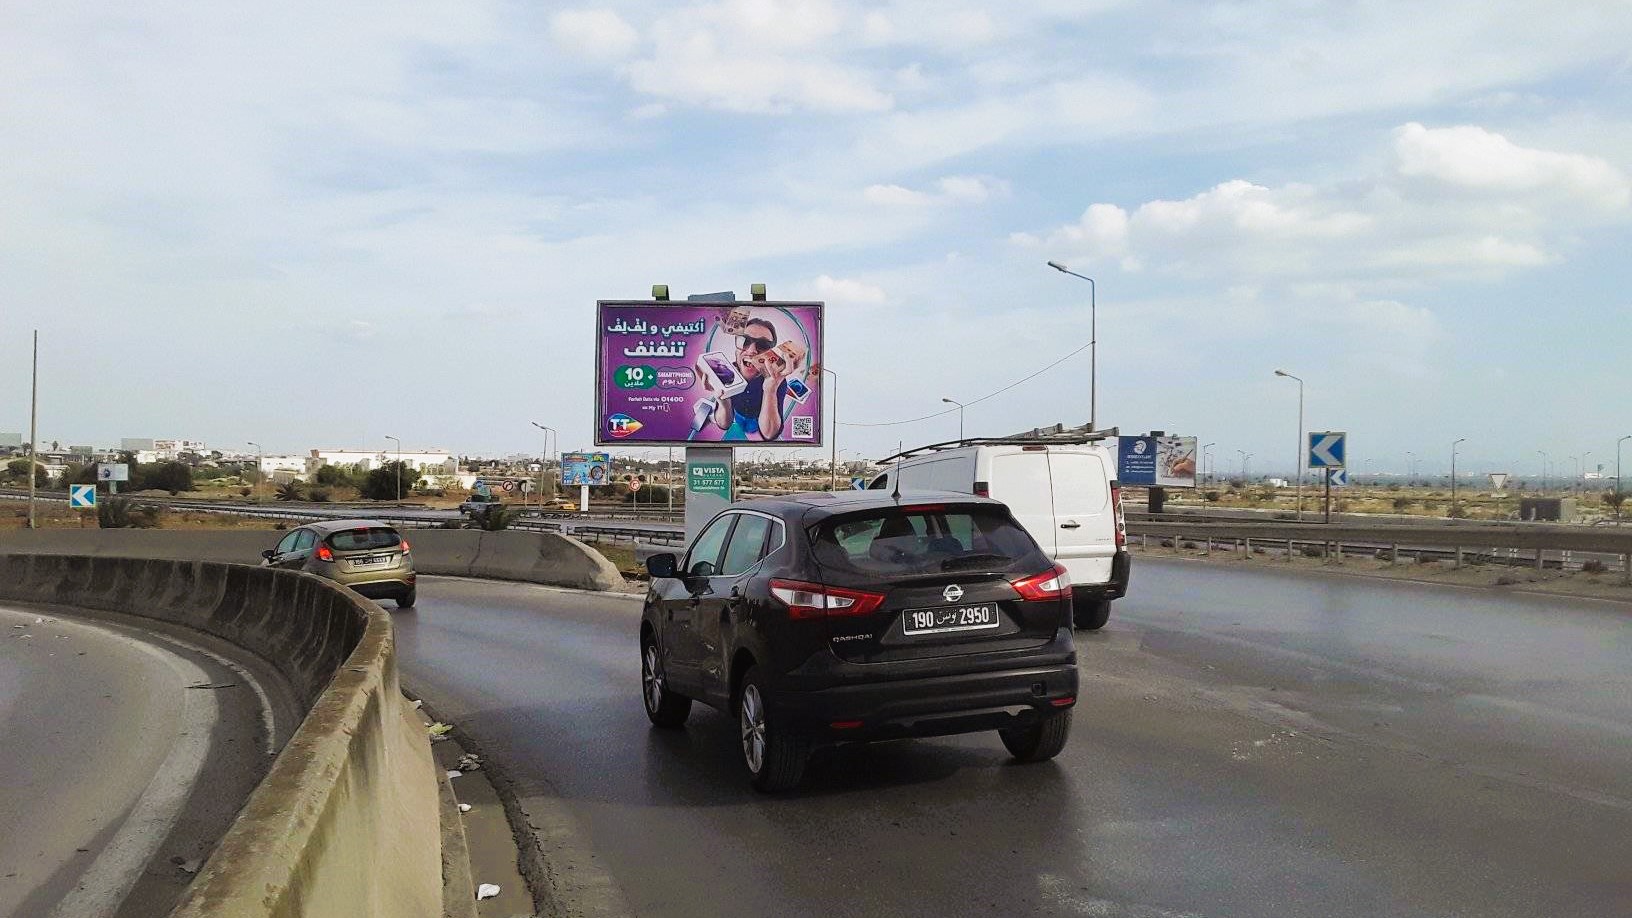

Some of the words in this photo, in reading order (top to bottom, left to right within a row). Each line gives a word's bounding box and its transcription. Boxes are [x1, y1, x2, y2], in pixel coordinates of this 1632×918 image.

[650, 324, 658, 335] و
[625, 367, 643, 380] 10
[610, 418, 630, 430] TT
[912, 611, 934, 629] 190
[936, 609, 957, 625] تونس
[959, 606, 989, 625] 2950
[832, 633, 873, 643] QASHQAI
